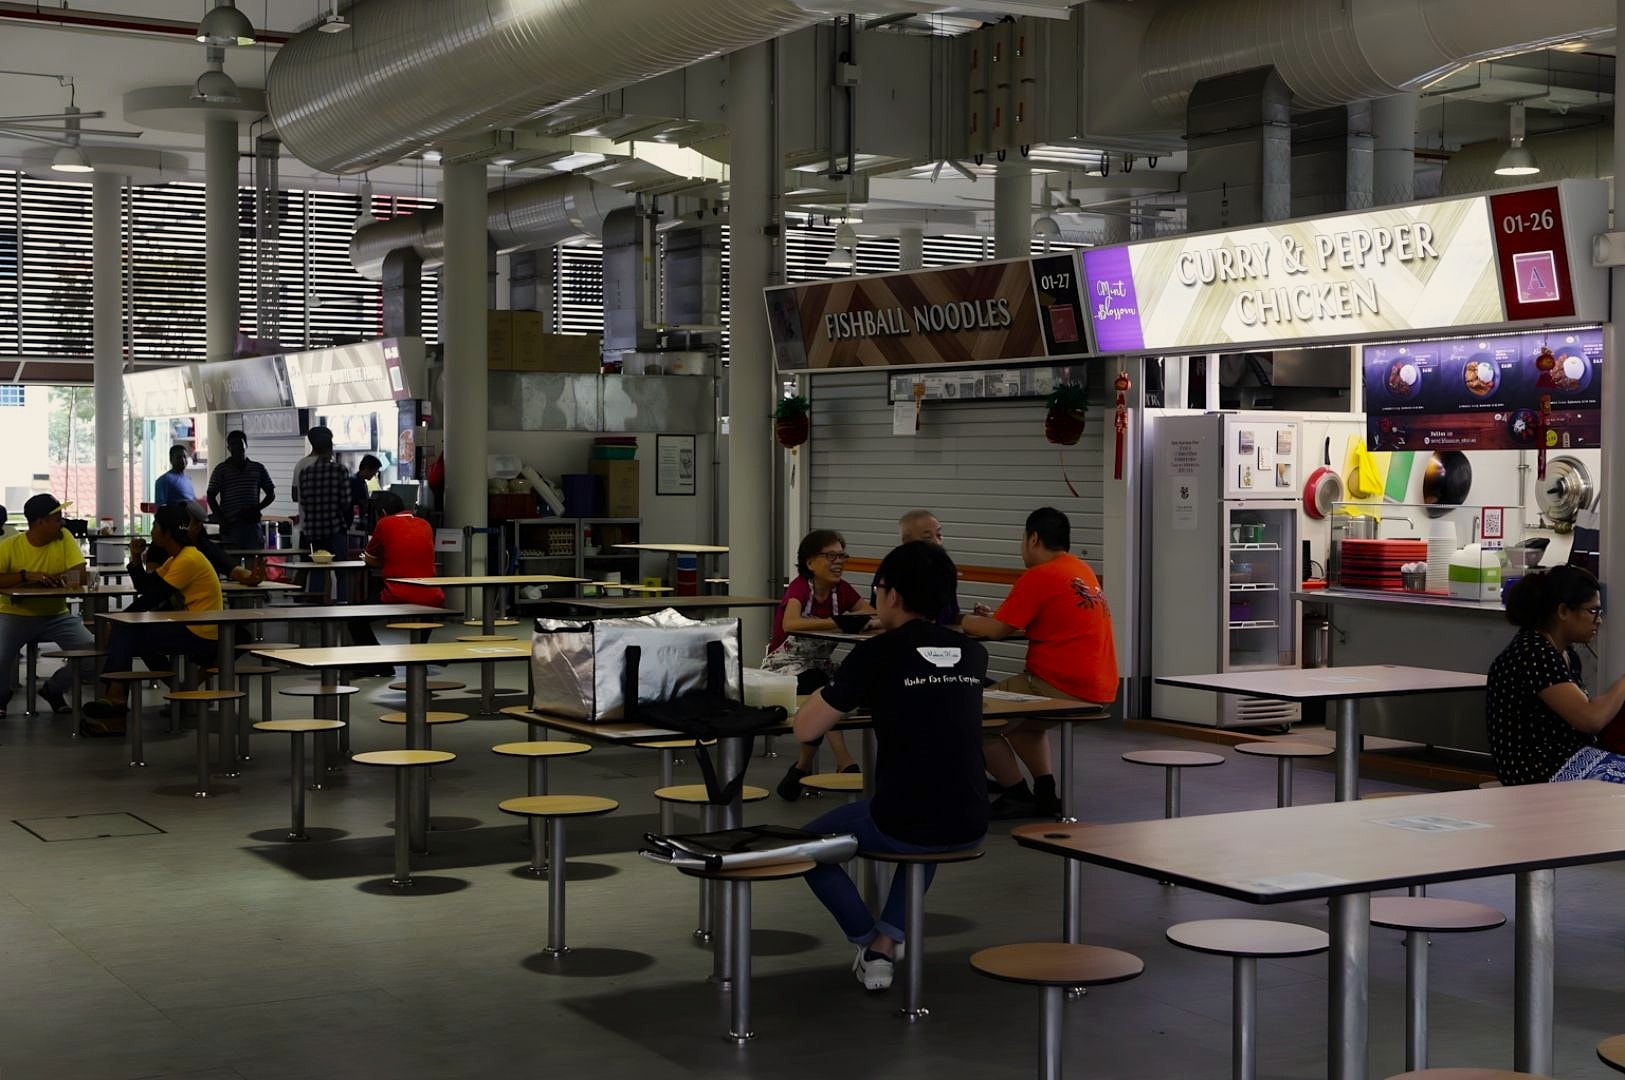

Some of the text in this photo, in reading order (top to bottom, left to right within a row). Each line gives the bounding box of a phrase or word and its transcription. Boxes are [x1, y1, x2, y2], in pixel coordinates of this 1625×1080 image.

[1503, 208, 1554, 234] 01-26
[1177, 222, 1439, 287] CURRY & PEPPER
[1041, 272, 1070, 290] 01-27
[1096, 280, 1127, 298] Mint
[1527, 265, 1546, 290] A
[1094, 295, 1136, 321] Blossom
[1235, 279, 1380, 325] CHICKEN
[825, 298, 1013, 340] FISHBALL NOODLES
